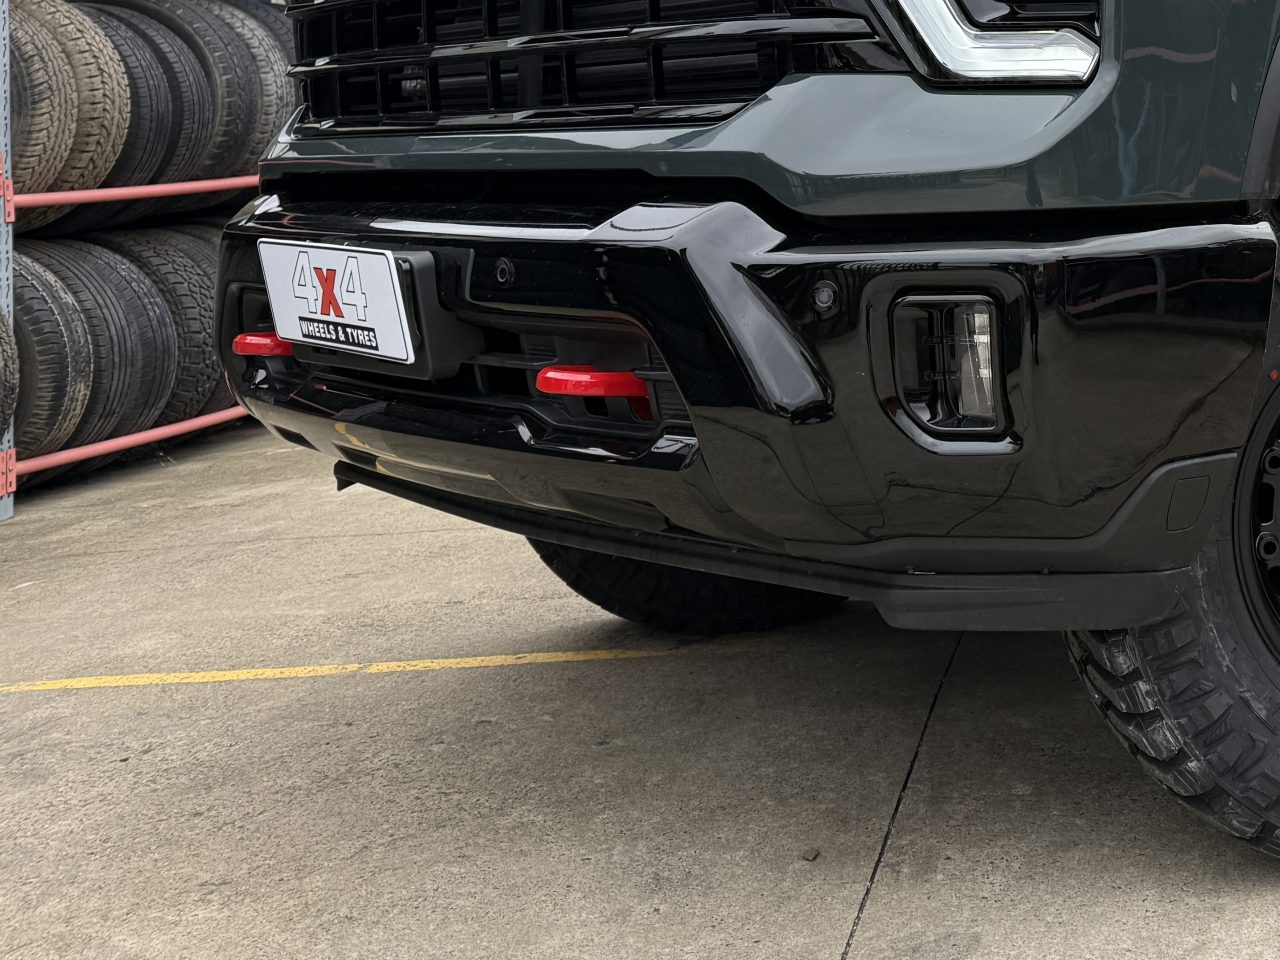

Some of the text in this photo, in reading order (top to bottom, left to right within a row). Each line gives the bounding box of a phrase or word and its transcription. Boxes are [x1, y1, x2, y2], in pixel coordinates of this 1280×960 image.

[301, 321, 377, 348] WHEELS & TYRES
